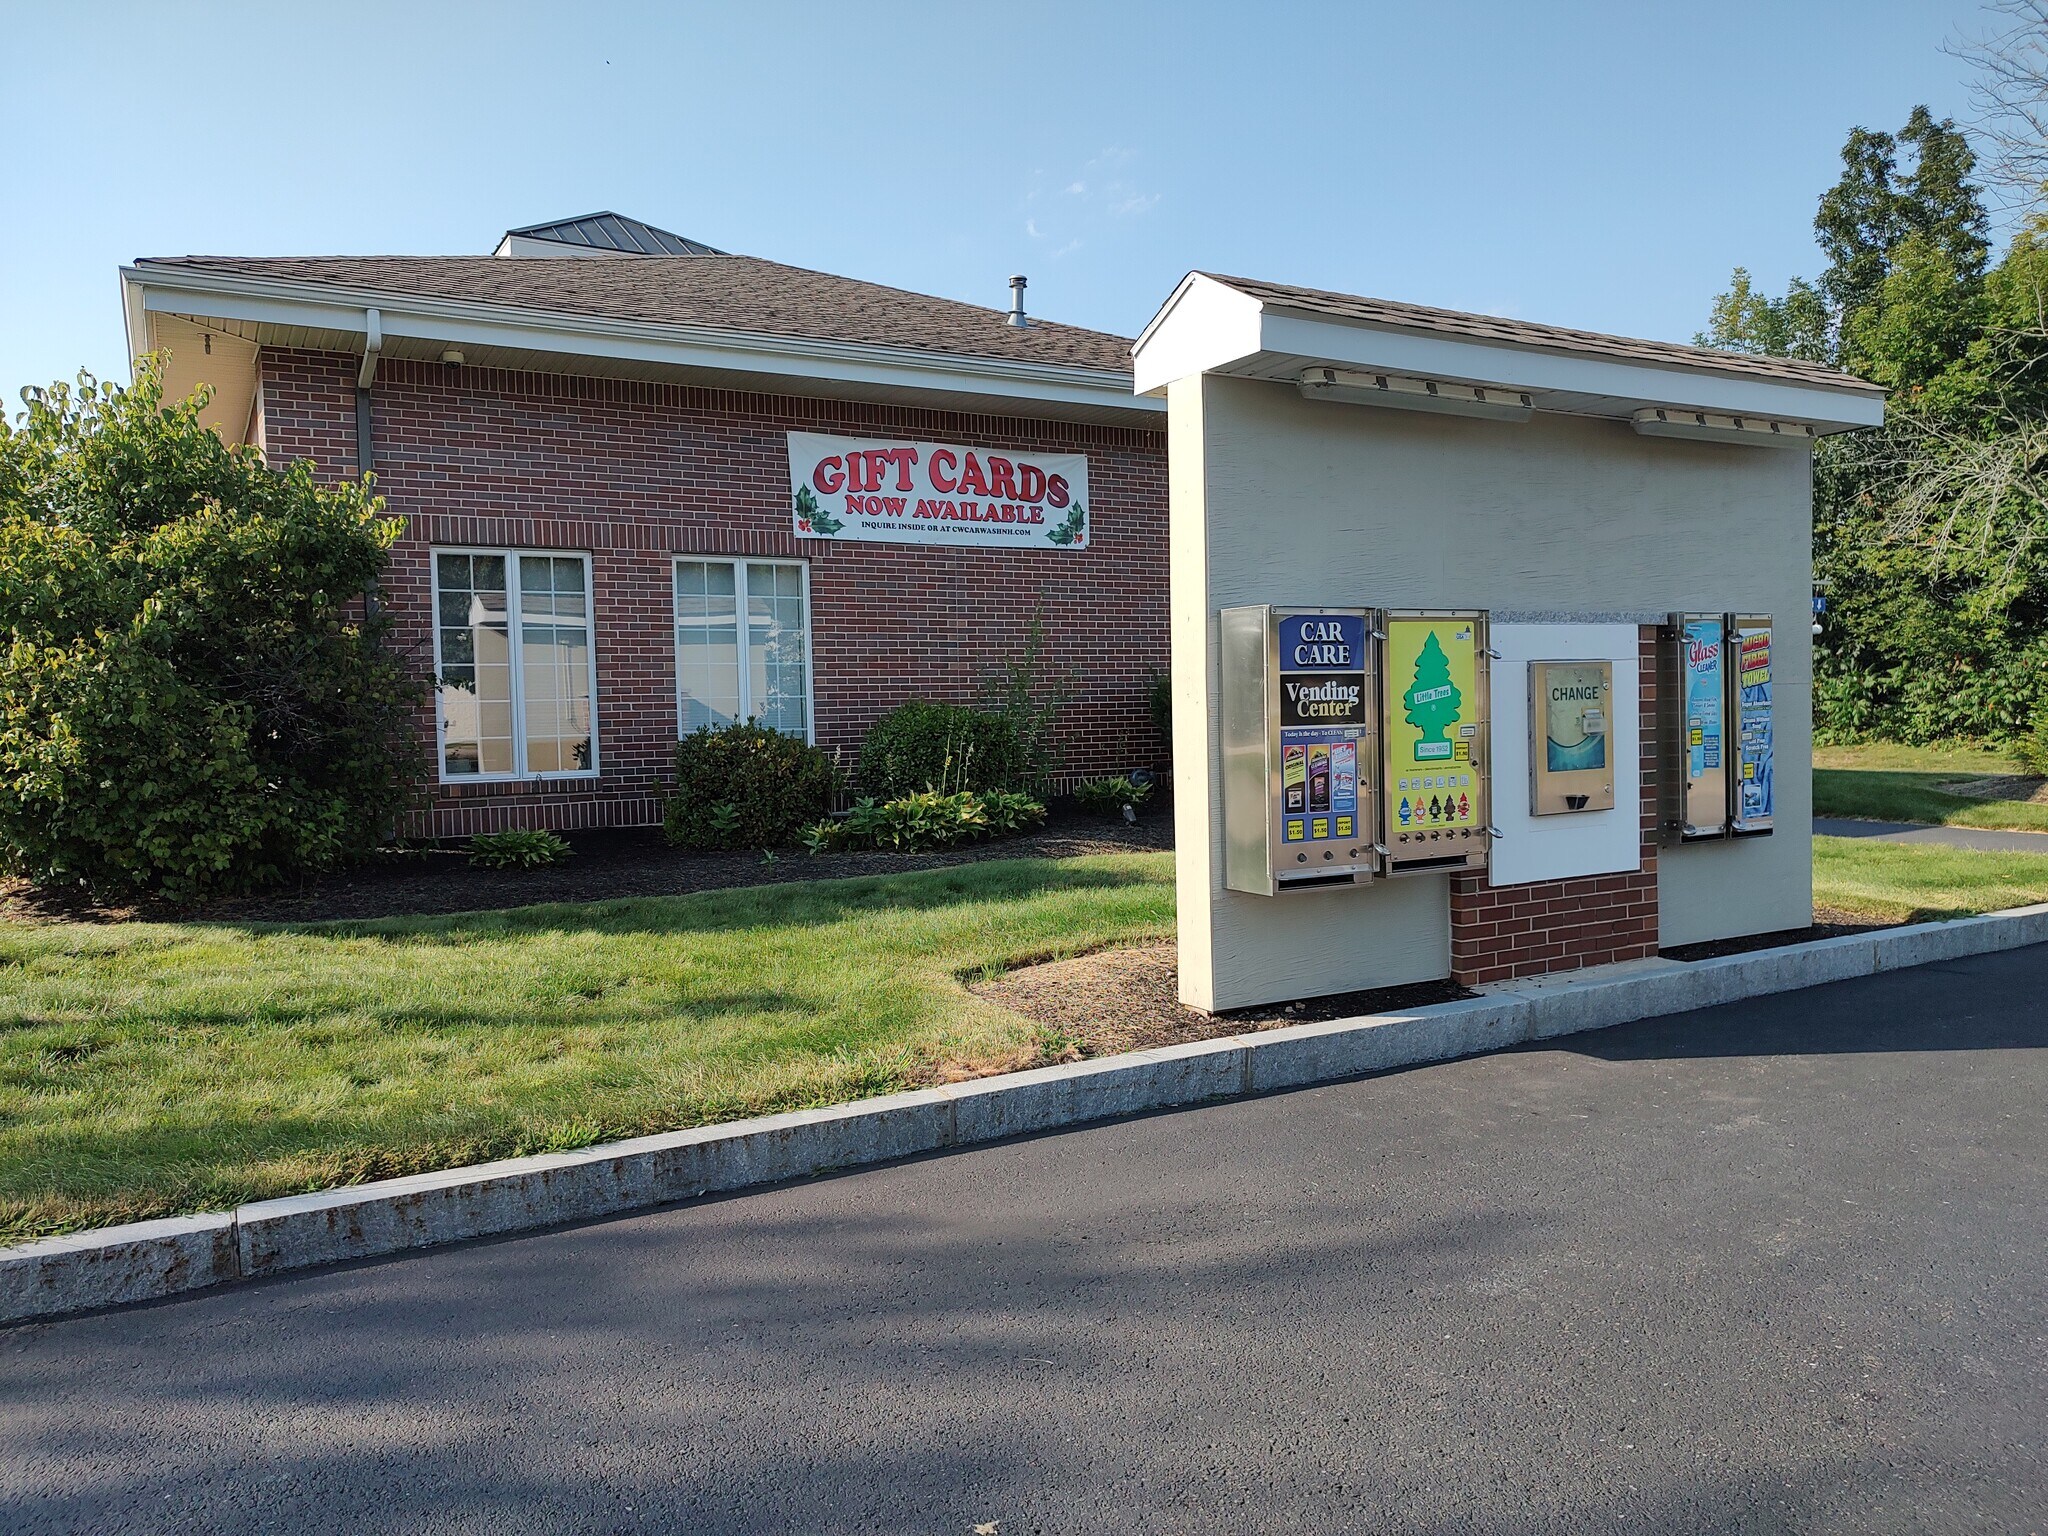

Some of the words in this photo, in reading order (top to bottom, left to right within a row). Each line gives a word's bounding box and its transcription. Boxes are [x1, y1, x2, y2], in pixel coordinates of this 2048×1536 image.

[812, 448, 918, 494] GIFT
[928, 448, 1070, 509] CARDS
[844, 494, 907, 517] NOW
[912, 499, 1045, 525] AVAILABLE
[861, 521, 897, 530] INQUIRE
[898, 523, 926, 531] INSIDE
[951, 526, 1031, 536] CWCARWASHNH.COM
[1300, 622, 1344, 643] CAR
[1741, 632, 1771, 654] MICRO
[1294, 645, 1351, 667] CARE
[1689, 640, 1719, 668] Glass
[1697, 660, 1718, 673] CLEANER
[1741, 669, 1769, 689] TOWEL
[1285, 681, 1360, 706] Vending
[1416, 692, 1432, 703] Little
[1434, 687, 1450, 698] Trees
[1552, 686, 1599, 701] CHANGE
[1297, 698, 1353, 717] Center
[1420, 745, 1435, 754] Since
[1436, 743, 1448, 753] 1952
[1285, 760, 1304, 770] ORIGINAL
